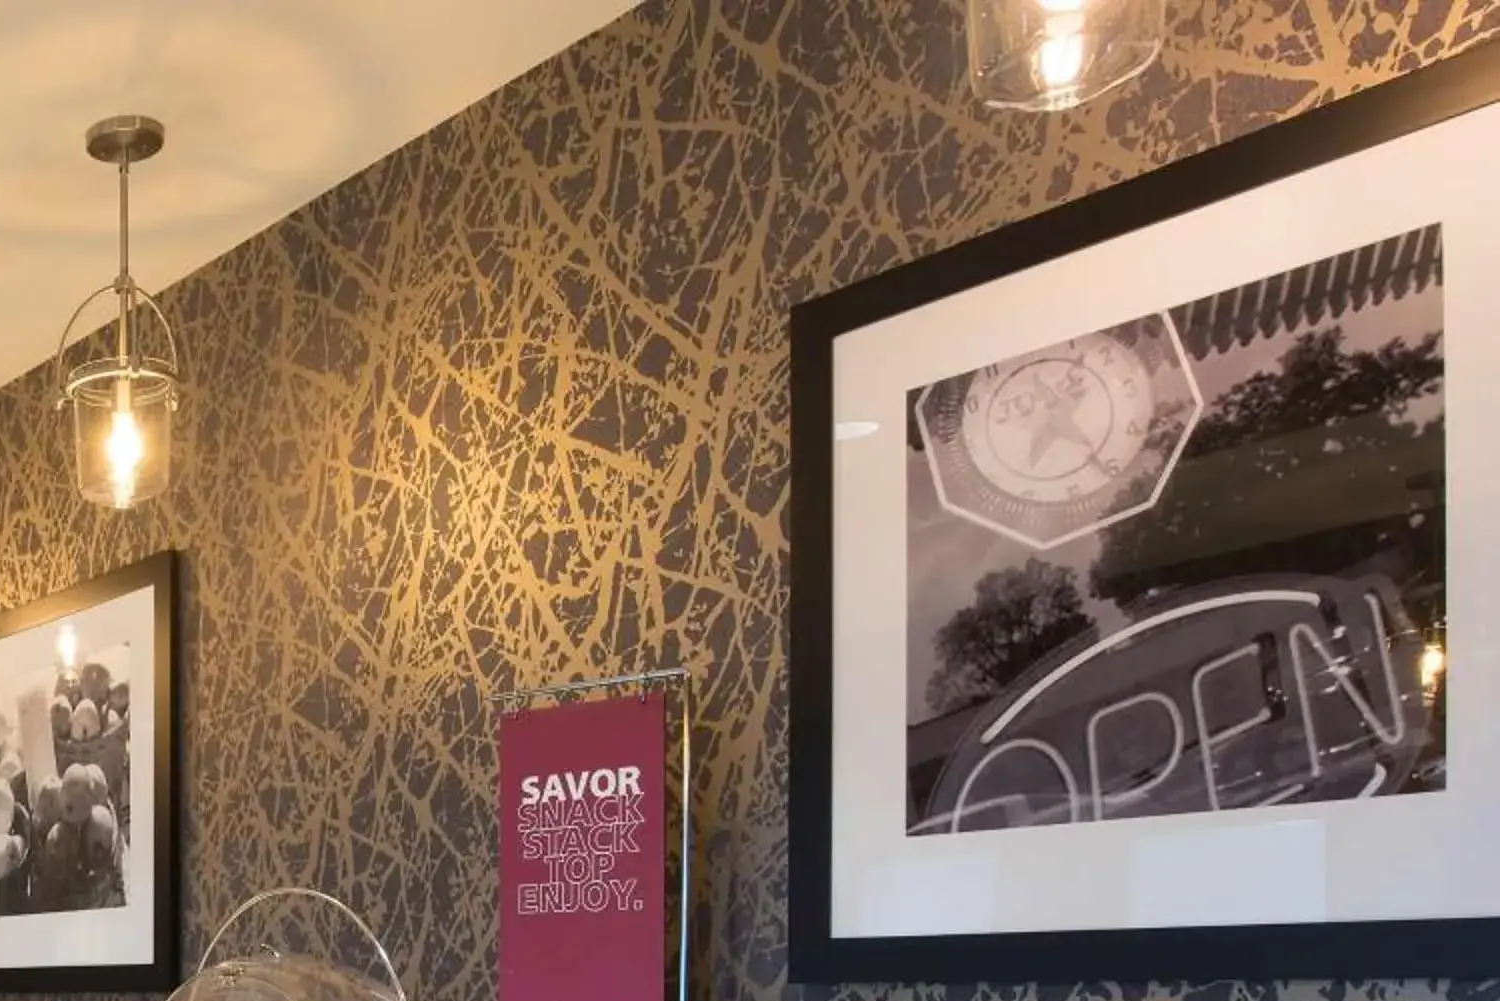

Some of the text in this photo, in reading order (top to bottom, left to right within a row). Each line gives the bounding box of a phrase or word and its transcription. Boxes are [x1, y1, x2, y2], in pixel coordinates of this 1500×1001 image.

[521, 765, 642, 805] SAVOR
[517, 793, 645, 833] SNACK
[523, 822, 640, 859] STACK
[544, 851, 615, 886] TOP
[517, 879, 644, 914] ENJOY.
